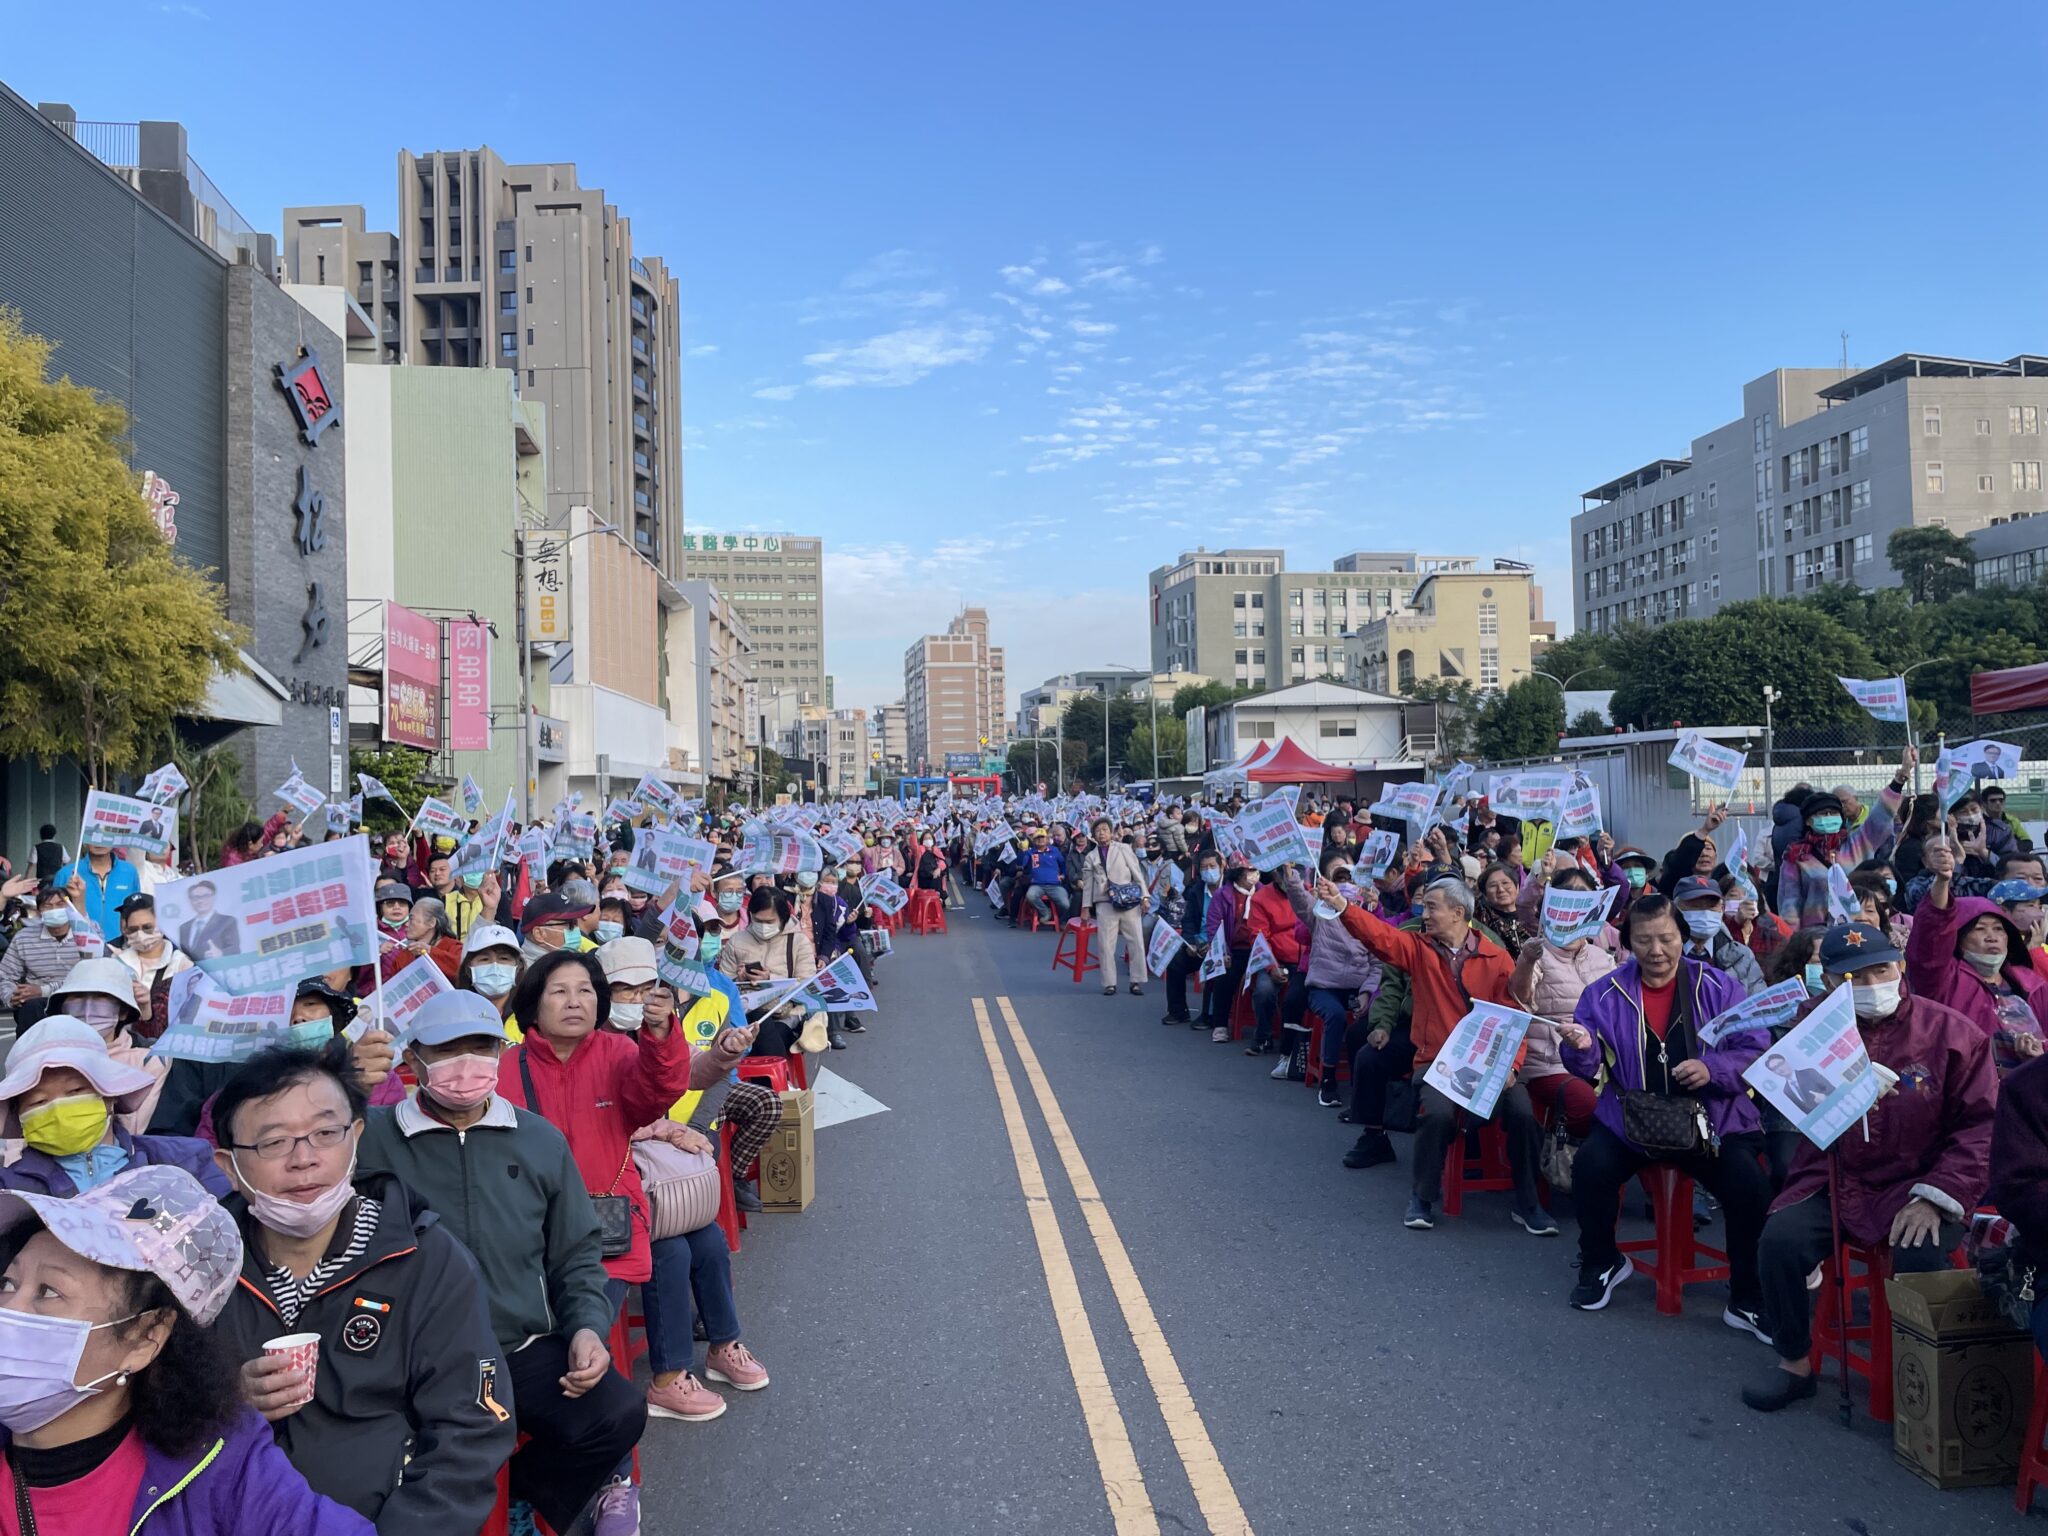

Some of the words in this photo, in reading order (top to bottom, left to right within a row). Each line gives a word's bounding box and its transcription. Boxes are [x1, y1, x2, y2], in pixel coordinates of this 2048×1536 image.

[683, 535, 779, 551] 基醫學中心
